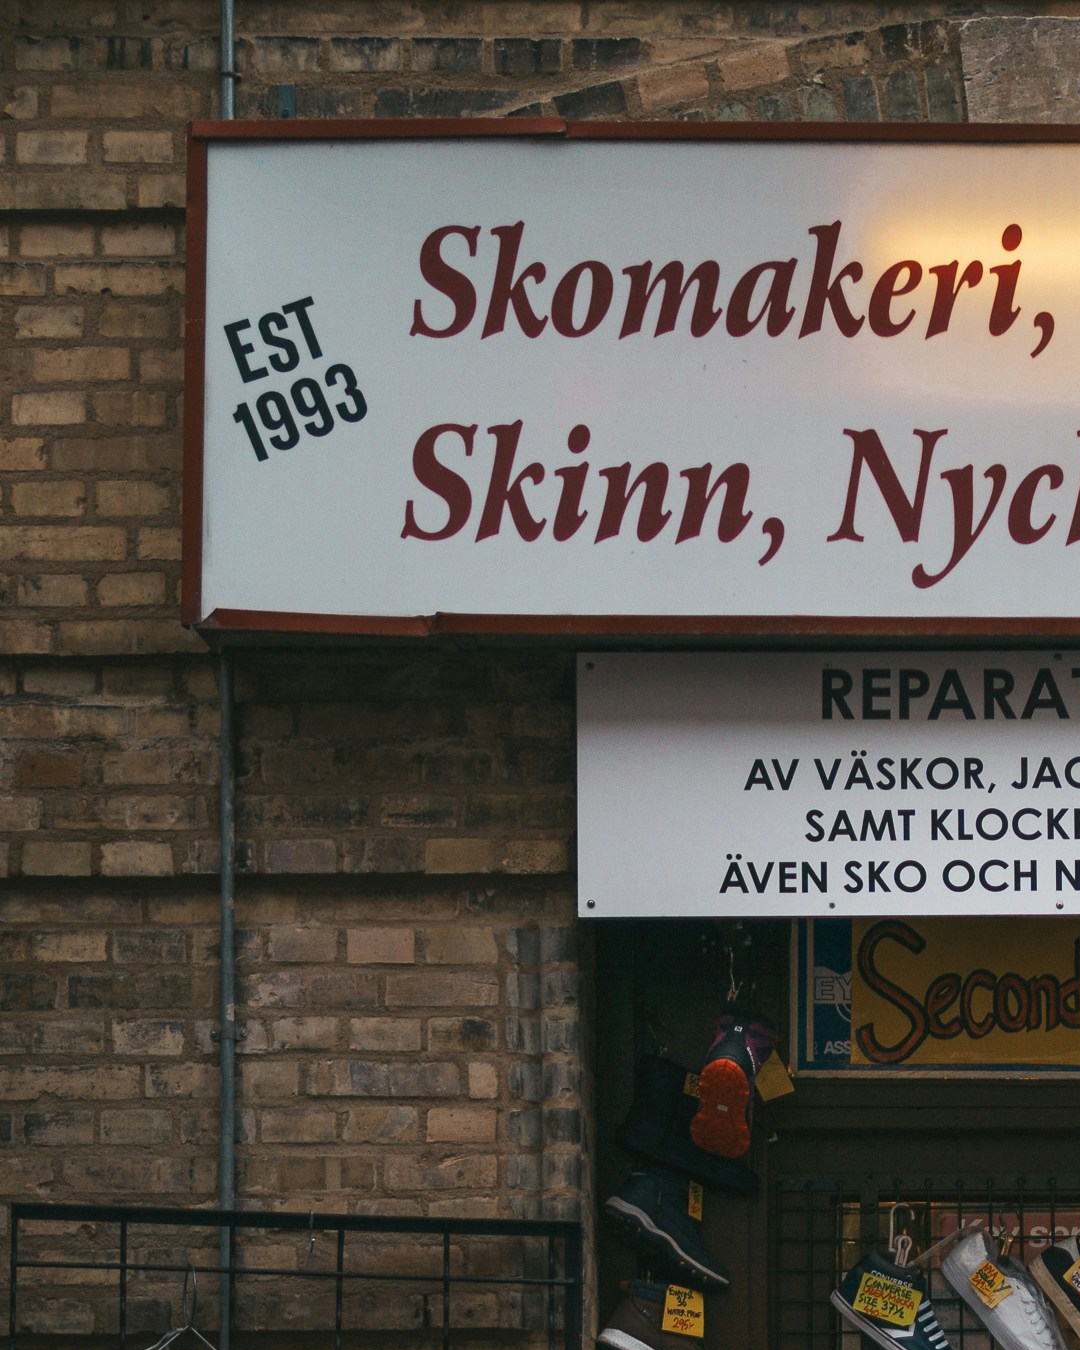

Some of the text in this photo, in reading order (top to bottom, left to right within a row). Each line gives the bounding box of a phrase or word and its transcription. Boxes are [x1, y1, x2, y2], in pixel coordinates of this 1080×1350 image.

[409, 220, 1054, 358] Skomakeri,
[223, 297, 325, 384] EST
[233, 363, 368, 462] 1993
[400, 419, 785, 566] Skinn,
[744, 758, 800, 790] AV
[816, 751, 996, 795] VÄSKOR,
[805, 809, 913, 842] SAMT
[719, 854, 829, 894] ÄVEN
[843, 860, 928, 893] SKO
[942, 859, 1038, 892] OCH
[858, 1293, 878, 1307] SIZE
[865, 1277, 912, 1300] CONVERSE
